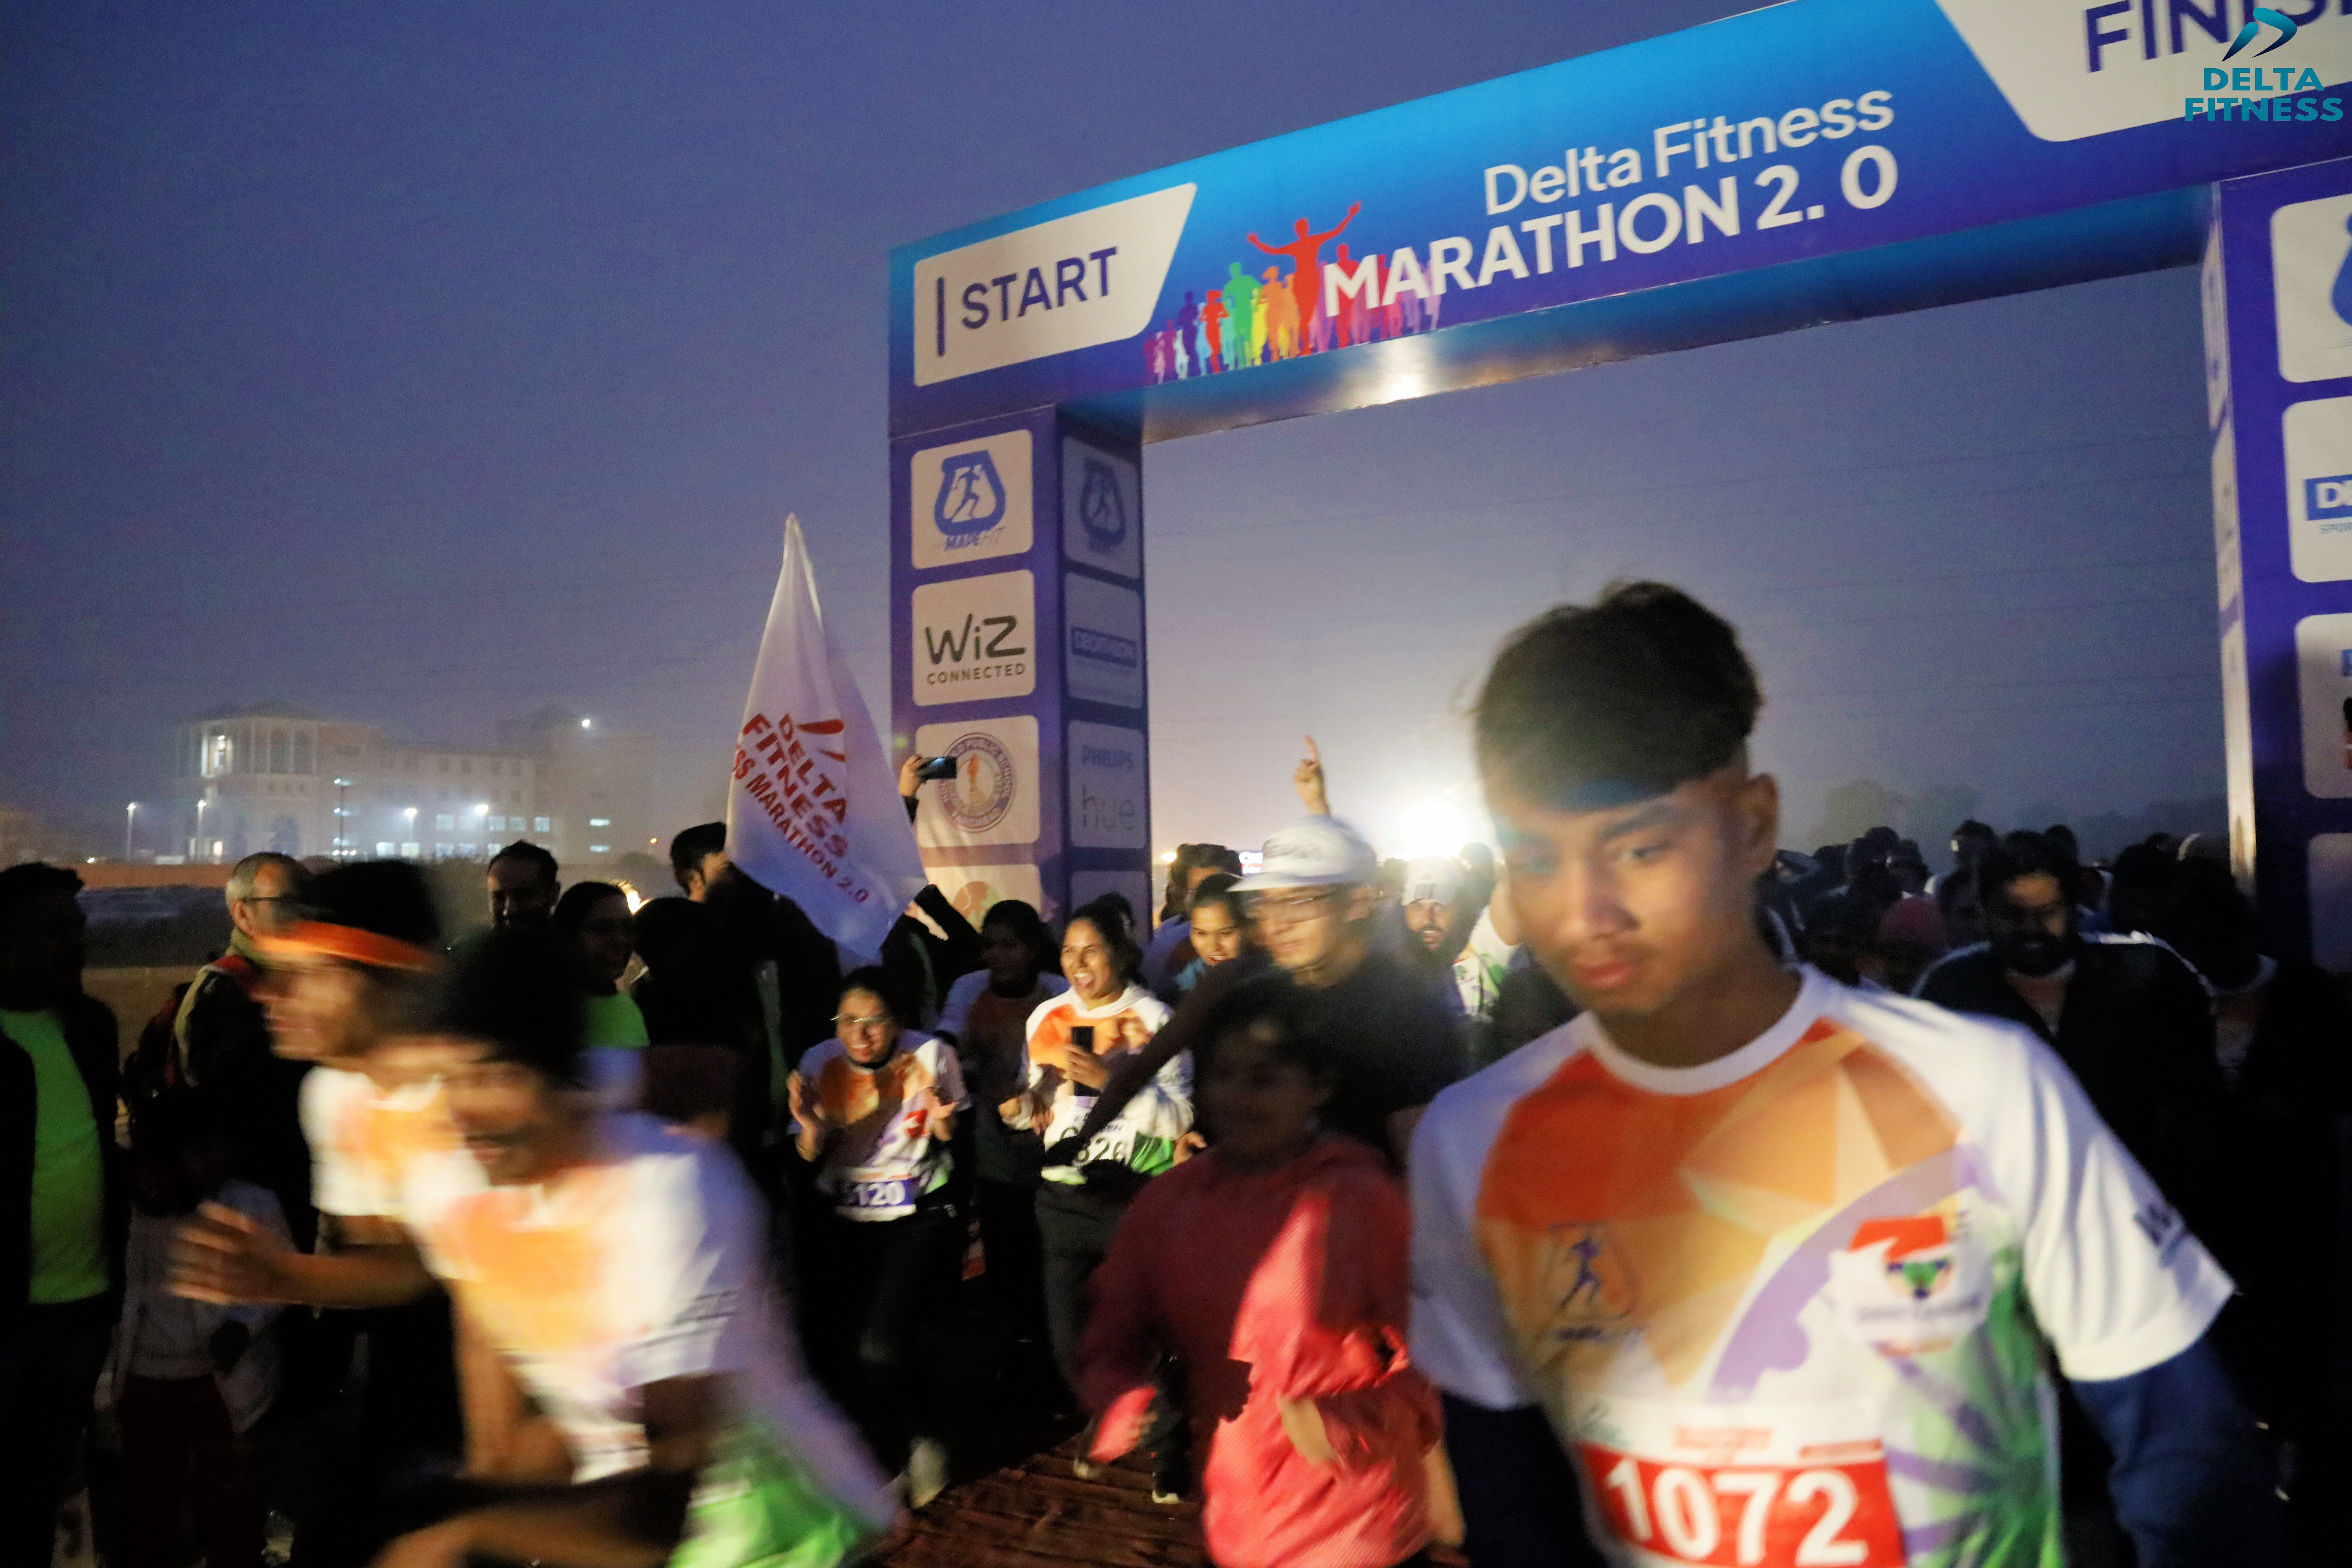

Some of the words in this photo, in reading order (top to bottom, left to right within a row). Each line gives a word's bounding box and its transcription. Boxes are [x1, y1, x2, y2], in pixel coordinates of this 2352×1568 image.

[1484, 146, 1642, 216] Delta
[1654, 90, 1895, 178] Fitness
[962, 246, 1118, 330] START
[1323, 175, 1741, 317] MARATHON
[925, 613, 1026, 665] WiZ
[926, 663, 1026, 684] CONNECTED
[743, 713, 848, 858] FITNESS
[778, 714, 847, 824] DELTA
[746, 773, 838, 878] MARATHON
[1606, 1457, 1868, 1566] 1072
